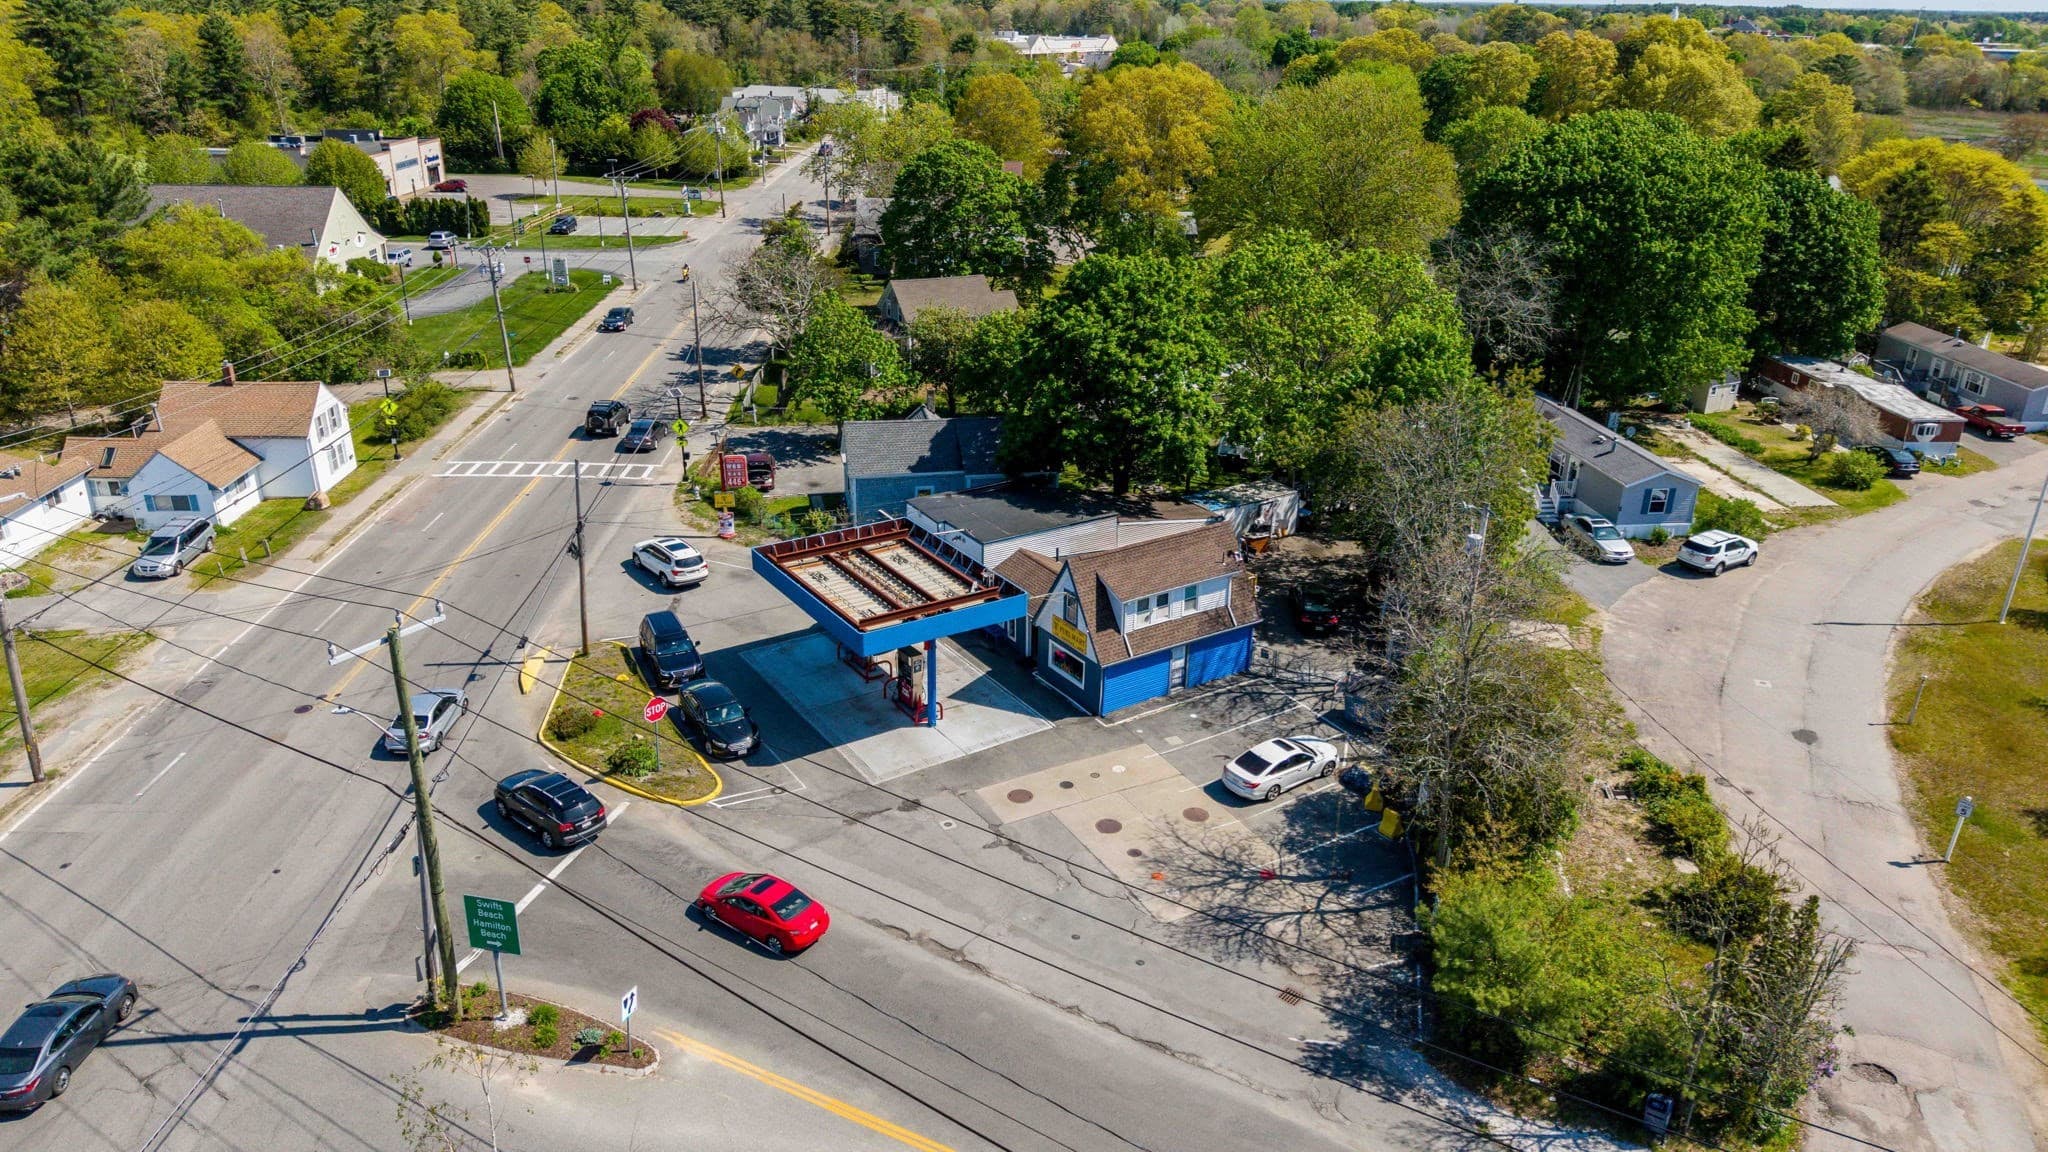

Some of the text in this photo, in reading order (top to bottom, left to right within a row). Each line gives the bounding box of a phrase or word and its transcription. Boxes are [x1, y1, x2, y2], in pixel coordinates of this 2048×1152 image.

[646, 702, 666, 717] STOP
[475, 899, 503, 911] Swifts
[477, 908, 504, 920] Beach
[472, 918, 512, 932] Hamilton
[480, 928, 507, 940] Beach
